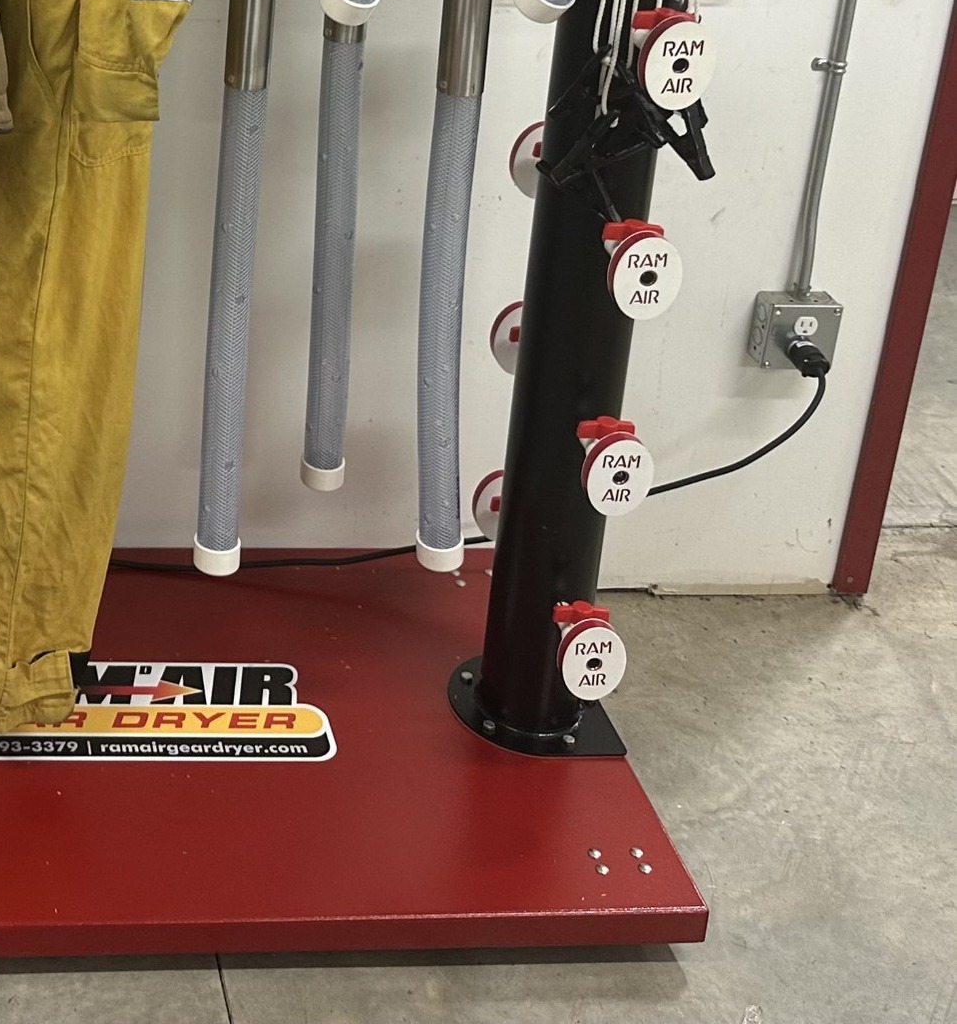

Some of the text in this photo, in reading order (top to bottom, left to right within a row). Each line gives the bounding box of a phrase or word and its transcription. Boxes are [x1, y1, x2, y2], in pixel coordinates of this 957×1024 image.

[662, 40, 705, 58] RAM
[661, 77, 693, 94] AIR
[627, 253, 669, 269] RAM
[629, 289, 660, 305] AIR
[602, 455, 641, 469] RAM
[601, 488, 630, 502] AIR
[575, 641, 613, 655] RAM
[578, 674, 606, 687] AIR
[111, 711, 297, 729] DRYER
[100, 740, 308, 756] ramairgeardryer.com
